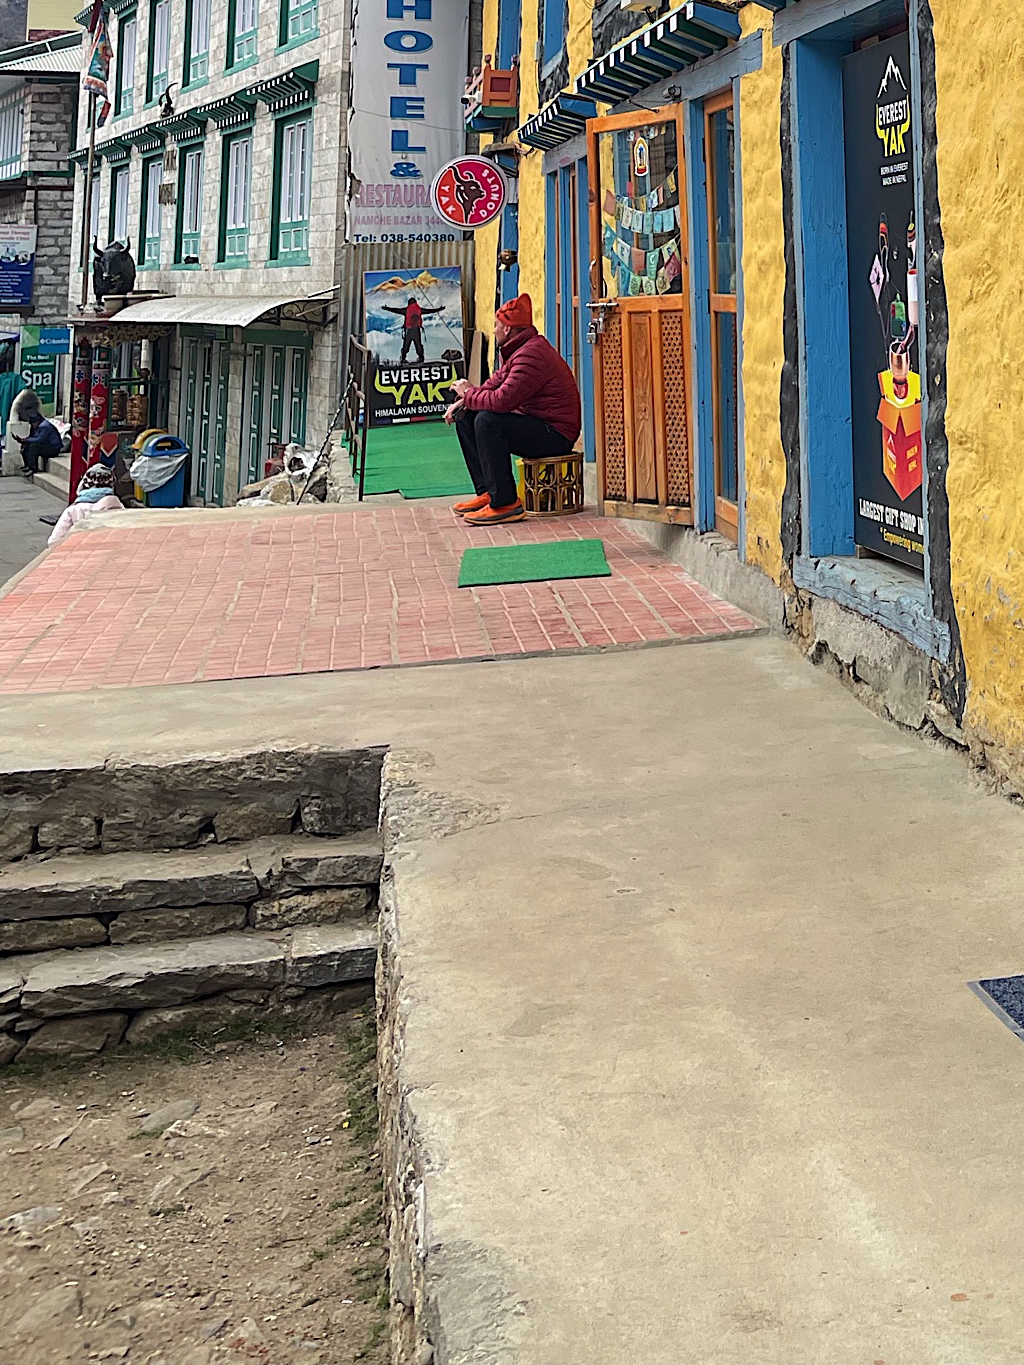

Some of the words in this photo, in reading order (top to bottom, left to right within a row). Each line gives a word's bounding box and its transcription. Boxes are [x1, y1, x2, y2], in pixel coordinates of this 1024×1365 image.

[879, 100, 907, 125] EVEREST
[883, 125, 906, 157] YAK
[390, 162, 424, 179] &
[440, 185, 457, 215] YAK
[479, 168, 500, 218] DONUTS
[355, 216, 391, 225] NAMCHE
[394, 216, 422, 225] BAZAR
[354, 234, 376, 242] Tel:
[381, 233, 455, 242] 038-540380
[21, 369, 53, 390] Spa
[381, 366, 450, 384] EVEREST
[391, 382, 445, 406] YAK
[375, 407, 416, 417] HIMALAYAN
[859, 498, 884, 523] LARGEST
[885, 506, 899, 527] GIFT
[900, 510, 916, 533] SHOP
